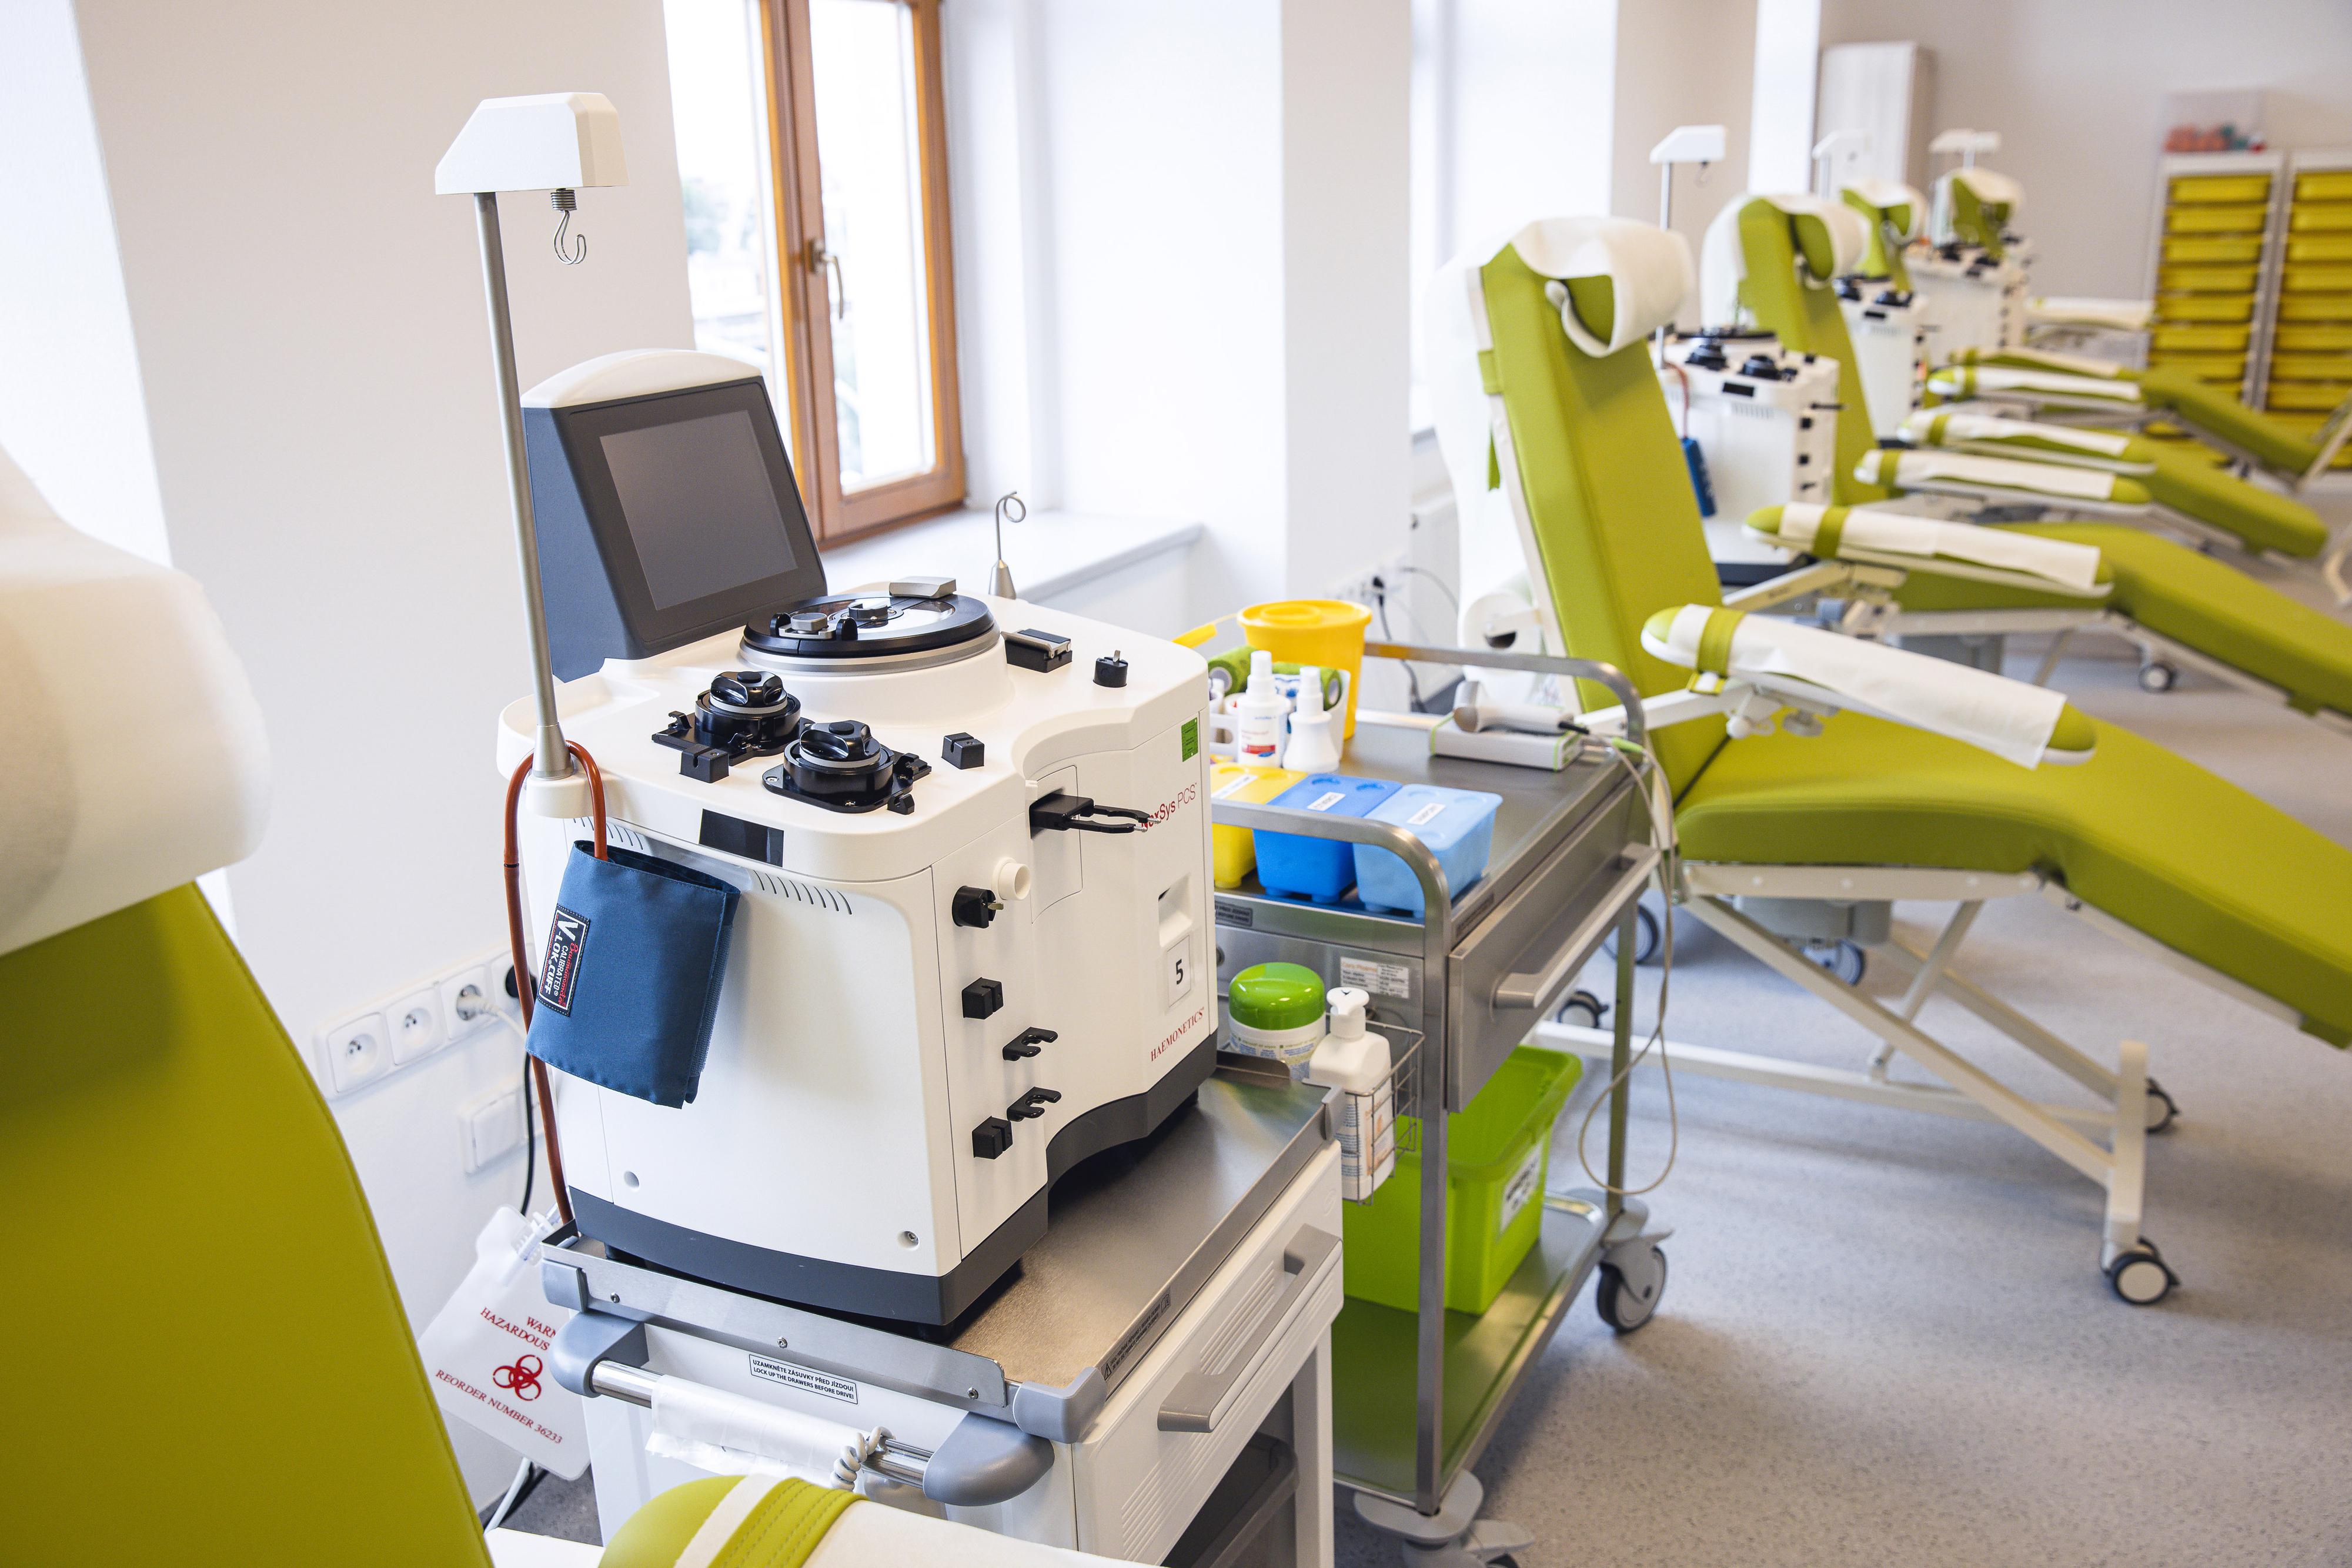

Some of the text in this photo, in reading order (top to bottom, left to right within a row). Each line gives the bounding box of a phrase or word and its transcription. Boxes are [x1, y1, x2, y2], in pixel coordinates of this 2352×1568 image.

[544, 965, 556, 995] CUFF
[1176, 959, 1184, 985] 5
[480, 1307, 550, 1351] HAZARDOUS
[753, 1359, 787, 1373] UZAMKNĚTE
[788, 1369, 814, 1381] ZÁSUVKY
[815, 1376, 830, 1385] PŘED
[753, 1367, 767, 1375] LOCK
[787, 1376, 813, 1388] DRAWERS
[814, 1384, 835, 1394] BEFORE
[435, 1369, 563, 1445] REORDER NUMBER 36233
